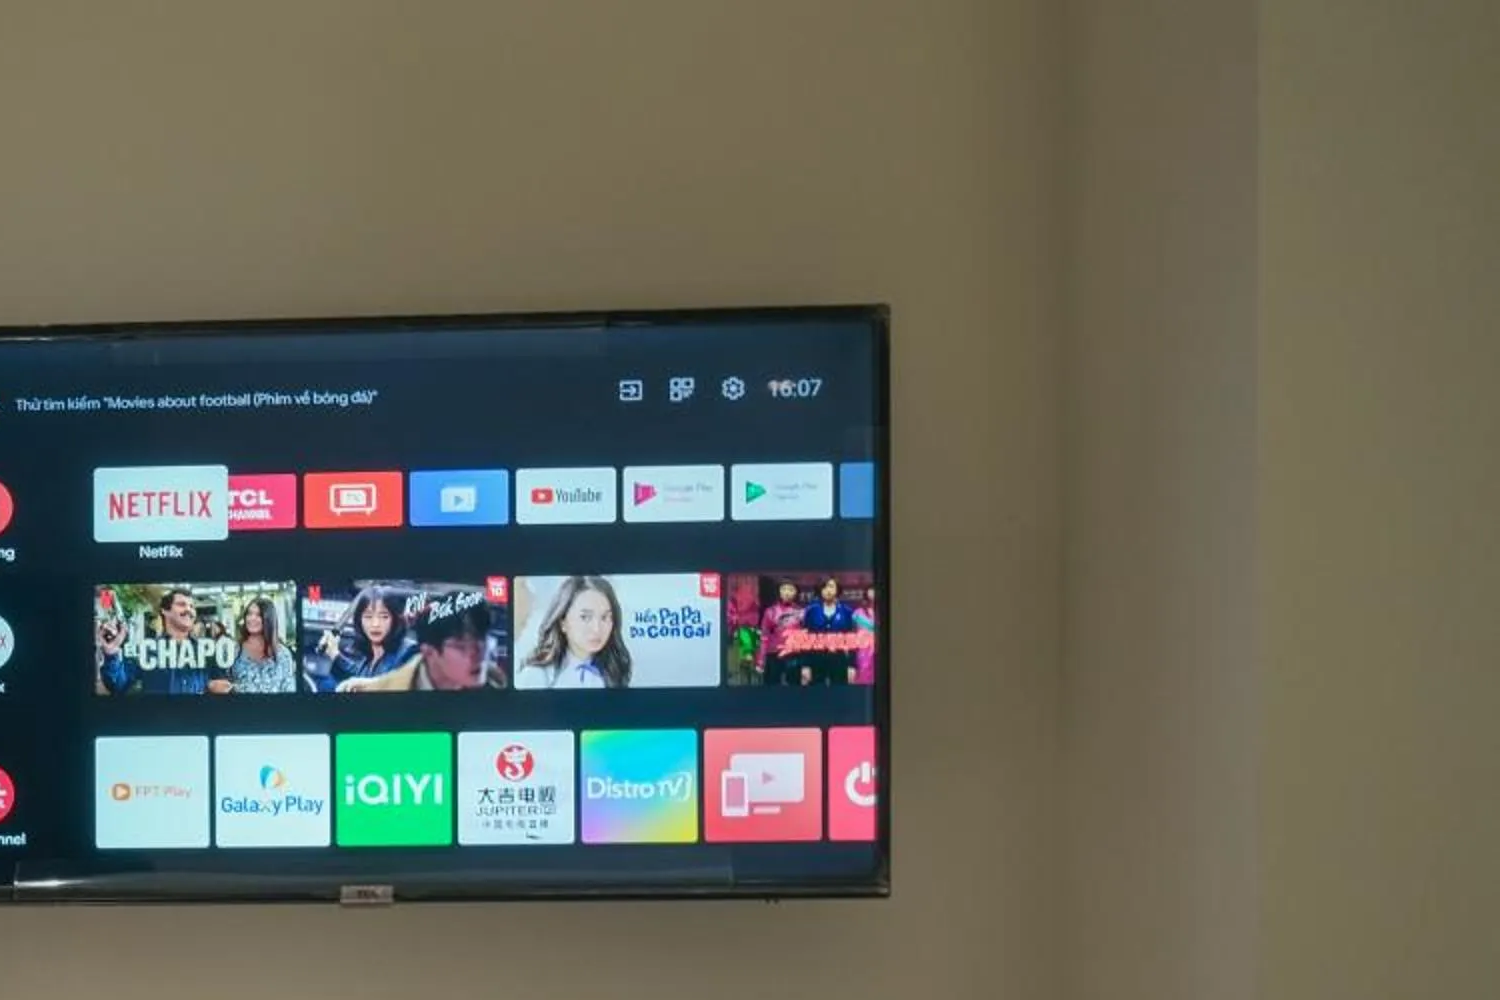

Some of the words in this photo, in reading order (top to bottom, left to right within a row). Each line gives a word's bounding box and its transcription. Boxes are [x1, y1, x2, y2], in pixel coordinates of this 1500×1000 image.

[767, 378, 823, 398] 16:07
[157, 394, 197, 409] about
[199, 392, 251, 408] football
[108, 490, 213, 521] NETFLIX
[555, 488, 603, 505] YouTube
[139, 545, 184, 559] Netflix
[138, 636, 236, 671] CHAPO
[344, 772, 444, 807] iQIYI
[221, 796, 284, 816] Galaxy
[285, 795, 324, 816] Play
